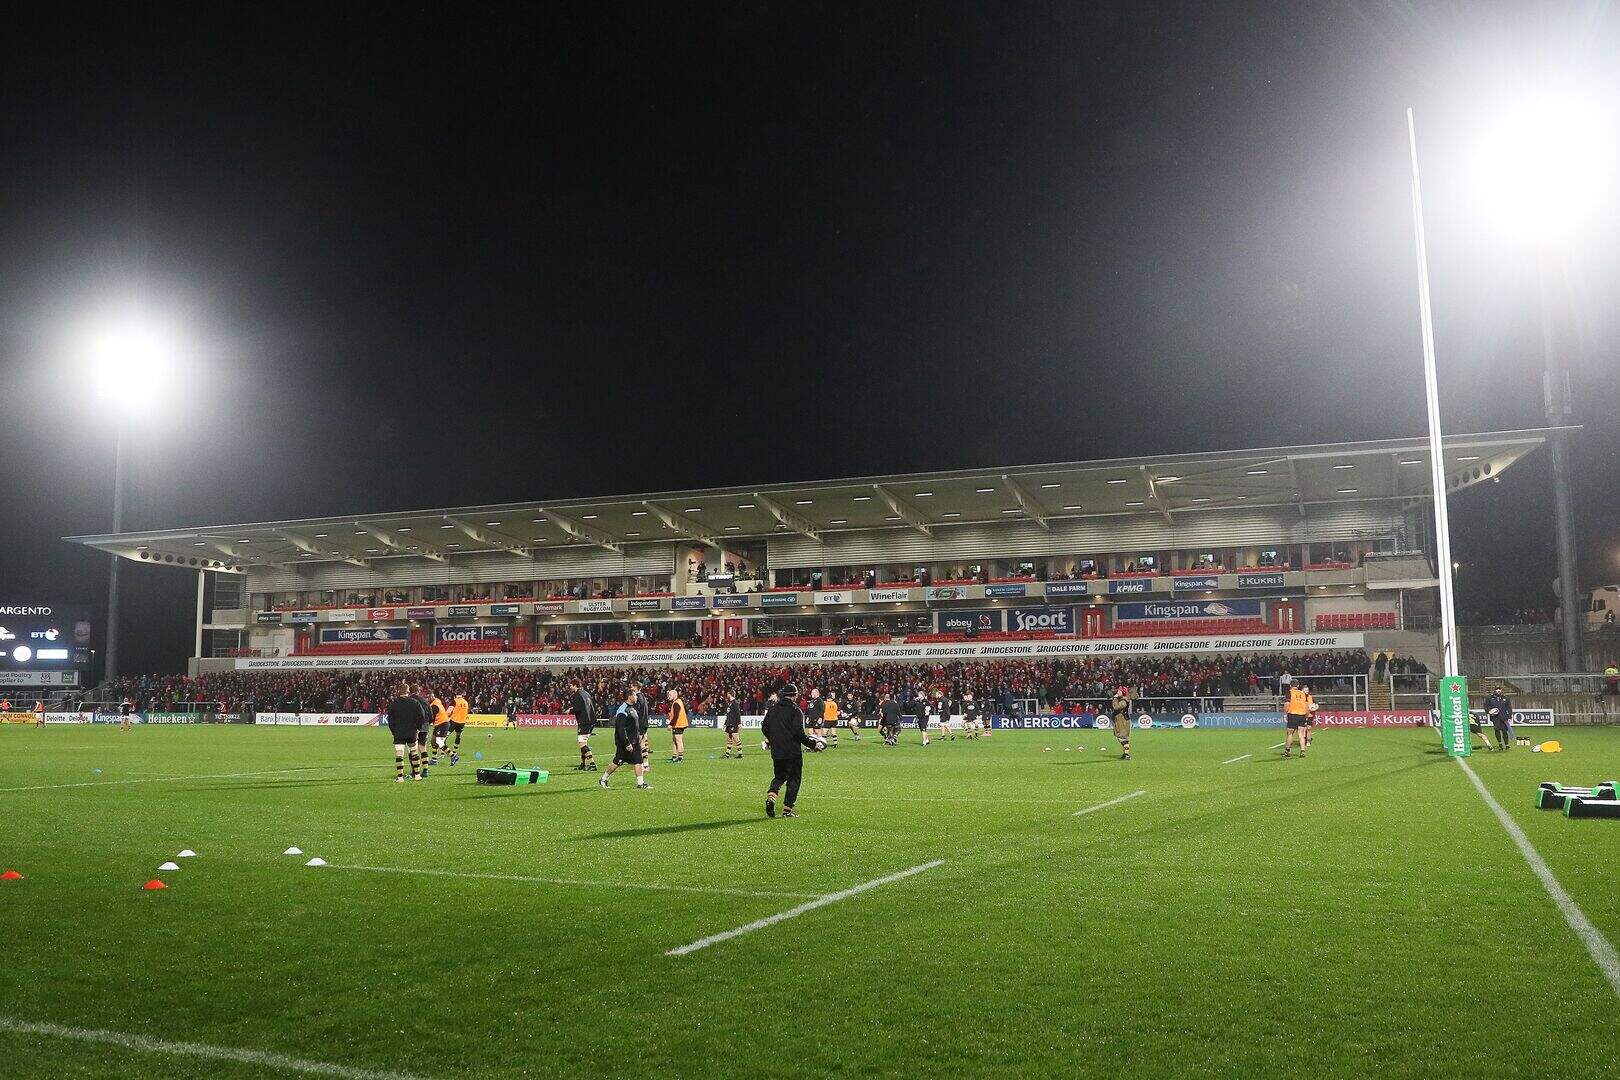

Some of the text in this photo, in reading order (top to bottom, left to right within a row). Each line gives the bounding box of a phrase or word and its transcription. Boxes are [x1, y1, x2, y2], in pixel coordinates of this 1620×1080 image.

[1116, 584, 1143, 592] KPMG
[1174, 580, 1204, 588] Kingspan
[871, 591, 908, 600] WineFlair
[1144, 604, 1199, 618] Kingspan
[946, 619, 972, 627] abbey
[338, 630, 371, 641] Kingspan
[148, 714, 188, 724] Heineken
[691, 718, 713, 726] abbey
[1325, 715, 1426, 725] KUKRI KUKRI
[1452, 696, 1465, 752] Heineken
